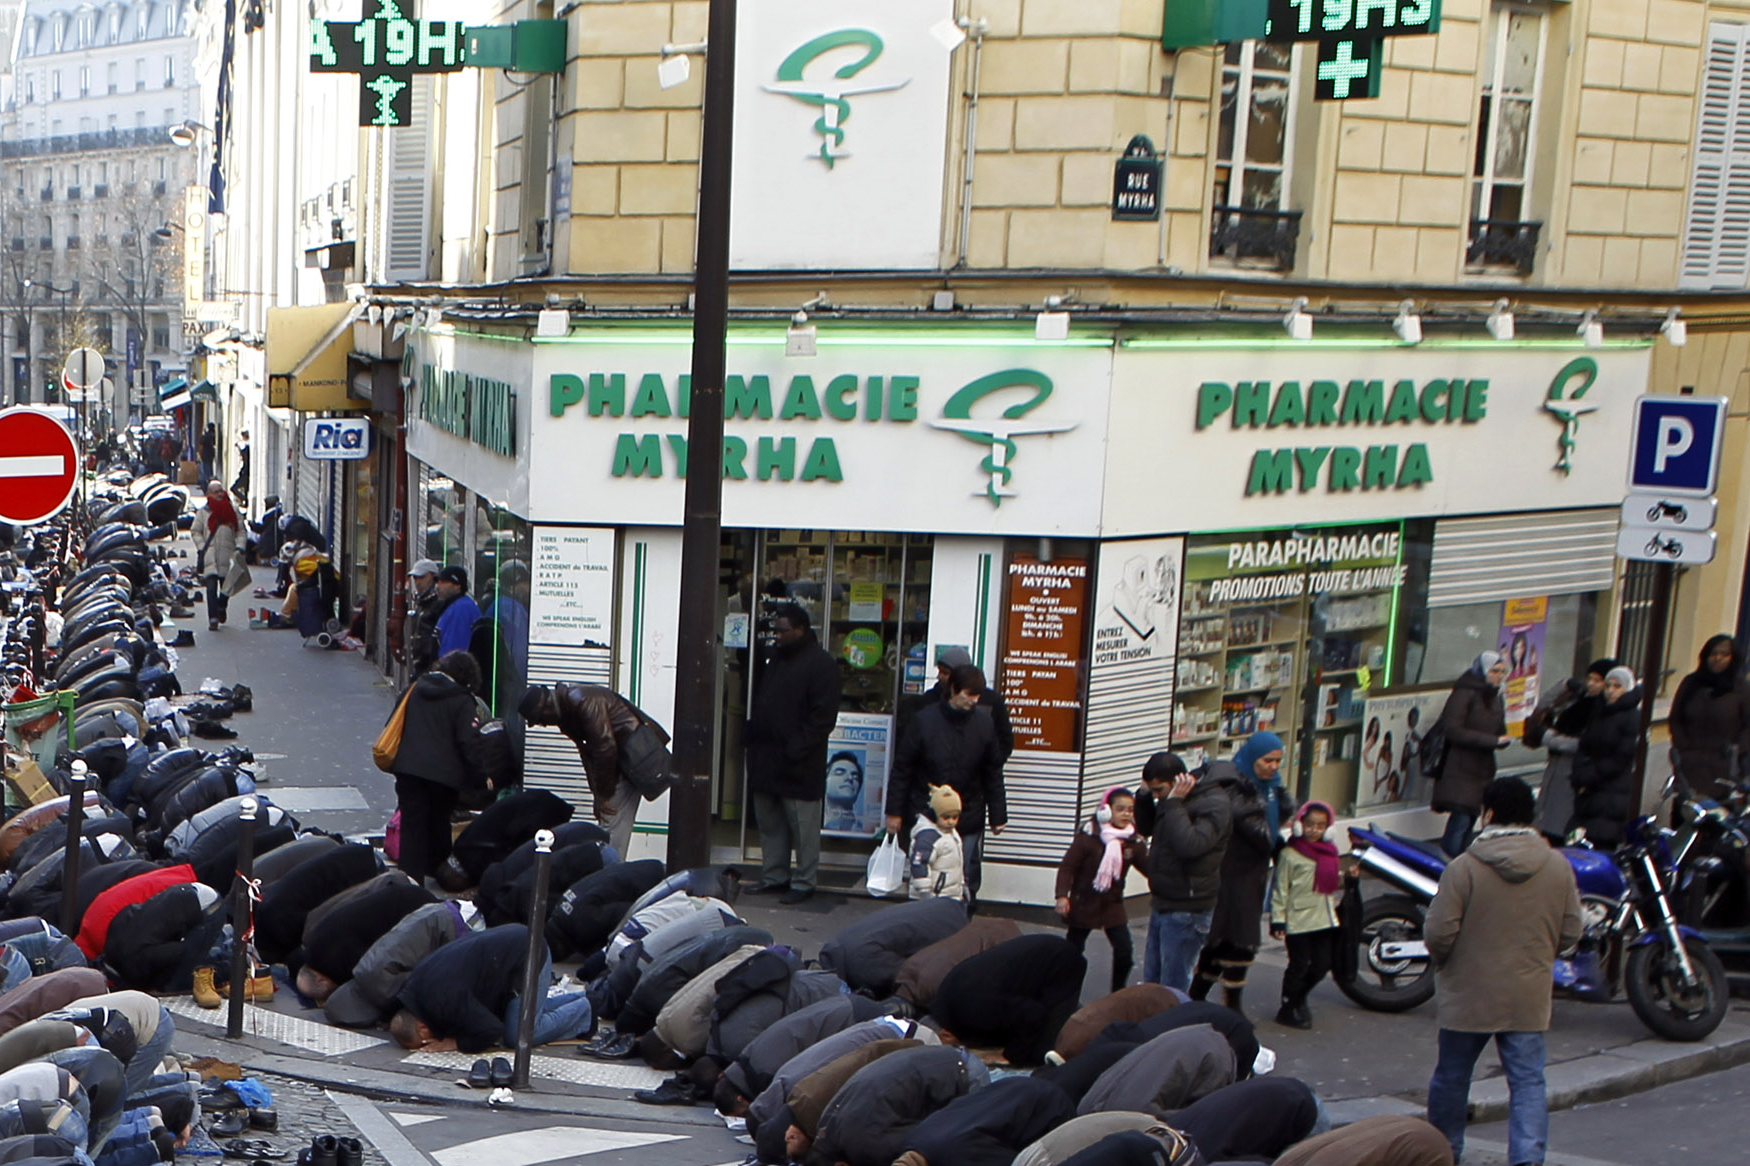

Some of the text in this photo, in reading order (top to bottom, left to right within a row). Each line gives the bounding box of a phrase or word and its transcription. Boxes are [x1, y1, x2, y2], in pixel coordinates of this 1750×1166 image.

[354, 19, 465, 65] 19H
[1127, 172, 1150, 190] RUE
[1118, 192, 1155, 209] MYRHA
[188, 187, 204, 300] HOTEL
[182, 322, 206, 334] PAX
[1196, 378, 1490, 430] PHARMACIE
[313, 422, 364, 450] Ria
[1653, 415, 1694, 473] P
[1246, 442, 1434, 496] MYRHA
[1227, 531, 1399, 570] PARAPHARMACIE
[1009, 563, 1087, 577] PHARMACIE
[1021, 576, 1072, 589] MYRHA
[1208, 573, 1306, 603] PROMOTIONS
[1307, 568, 1352, 595] TOUTE
[1029, 596, 1060, 605] OUVERT
[1011, 604, 1035, 612] LUNDI
[1048, 606, 1077, 614] SAMEDI
[1022, 621, 1063, 630] DIMANCHE
[1097, 626, 1124, 639] ENTREZ
[1096, 638, 1129, 651] MESURER
[1003, 657, 1049, 666] COMPRENONS
[1095, 647, 1152, 664] VOTRE TENSION
[1006, 669, 1026, 677] TIERS
[1004, 698, 1081, 708] ACCIDENT de TRAVAIL
